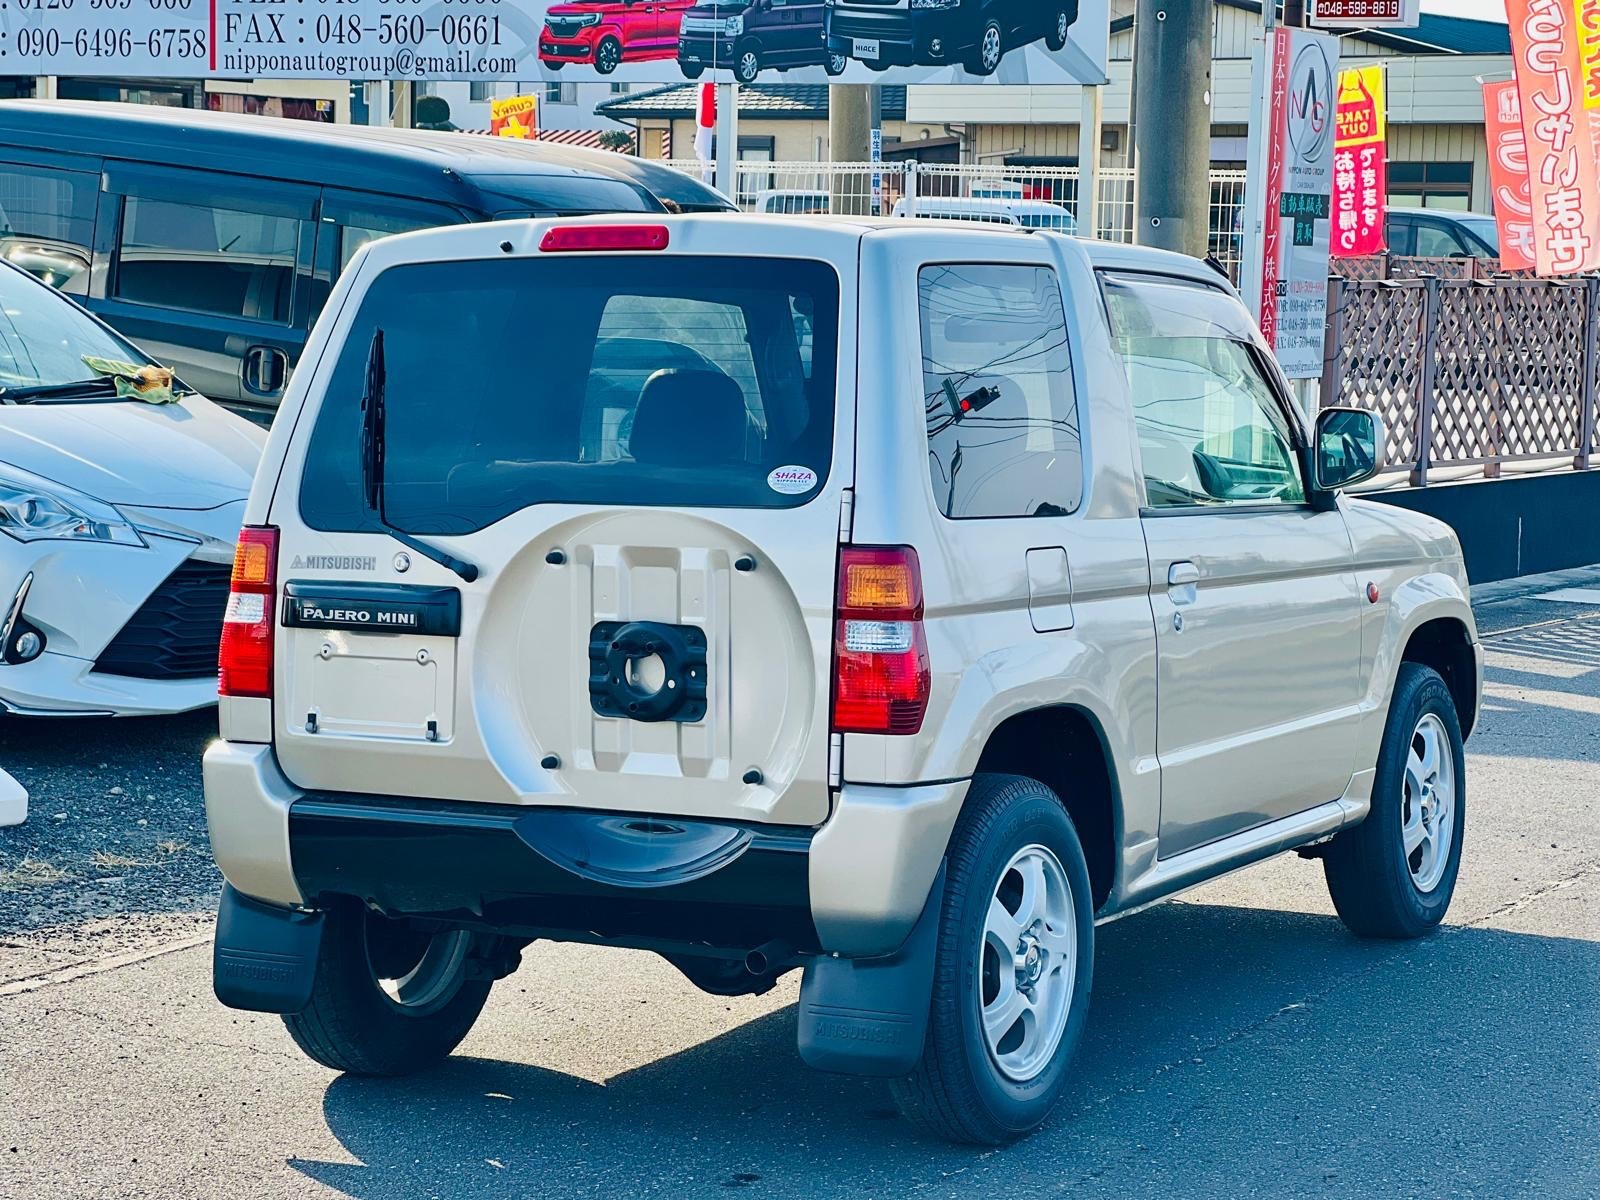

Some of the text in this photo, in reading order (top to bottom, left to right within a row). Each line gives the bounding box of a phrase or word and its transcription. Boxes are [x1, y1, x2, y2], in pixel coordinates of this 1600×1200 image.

[1325, 1, 1398, 15] 048-598-8619
[224, 13, 286, 43] FAX
[316, 14, 502, 45] 048-560-0661
[17, 28, 206, 58] 090-6496-6758
[855, 45, 877, 53] HIACE
[224, 48, 517, 75] nipponautogroup@gmail.com
[1280, 193, 1323, 216] 自動車販売
[1295, 222, 1313, 243] 買取
[774, 472, 812, 480] SHAZA
[306, 556, 377, 571] MITSUBISHI
[303, 608, 415, 625] PAJERO MINI
